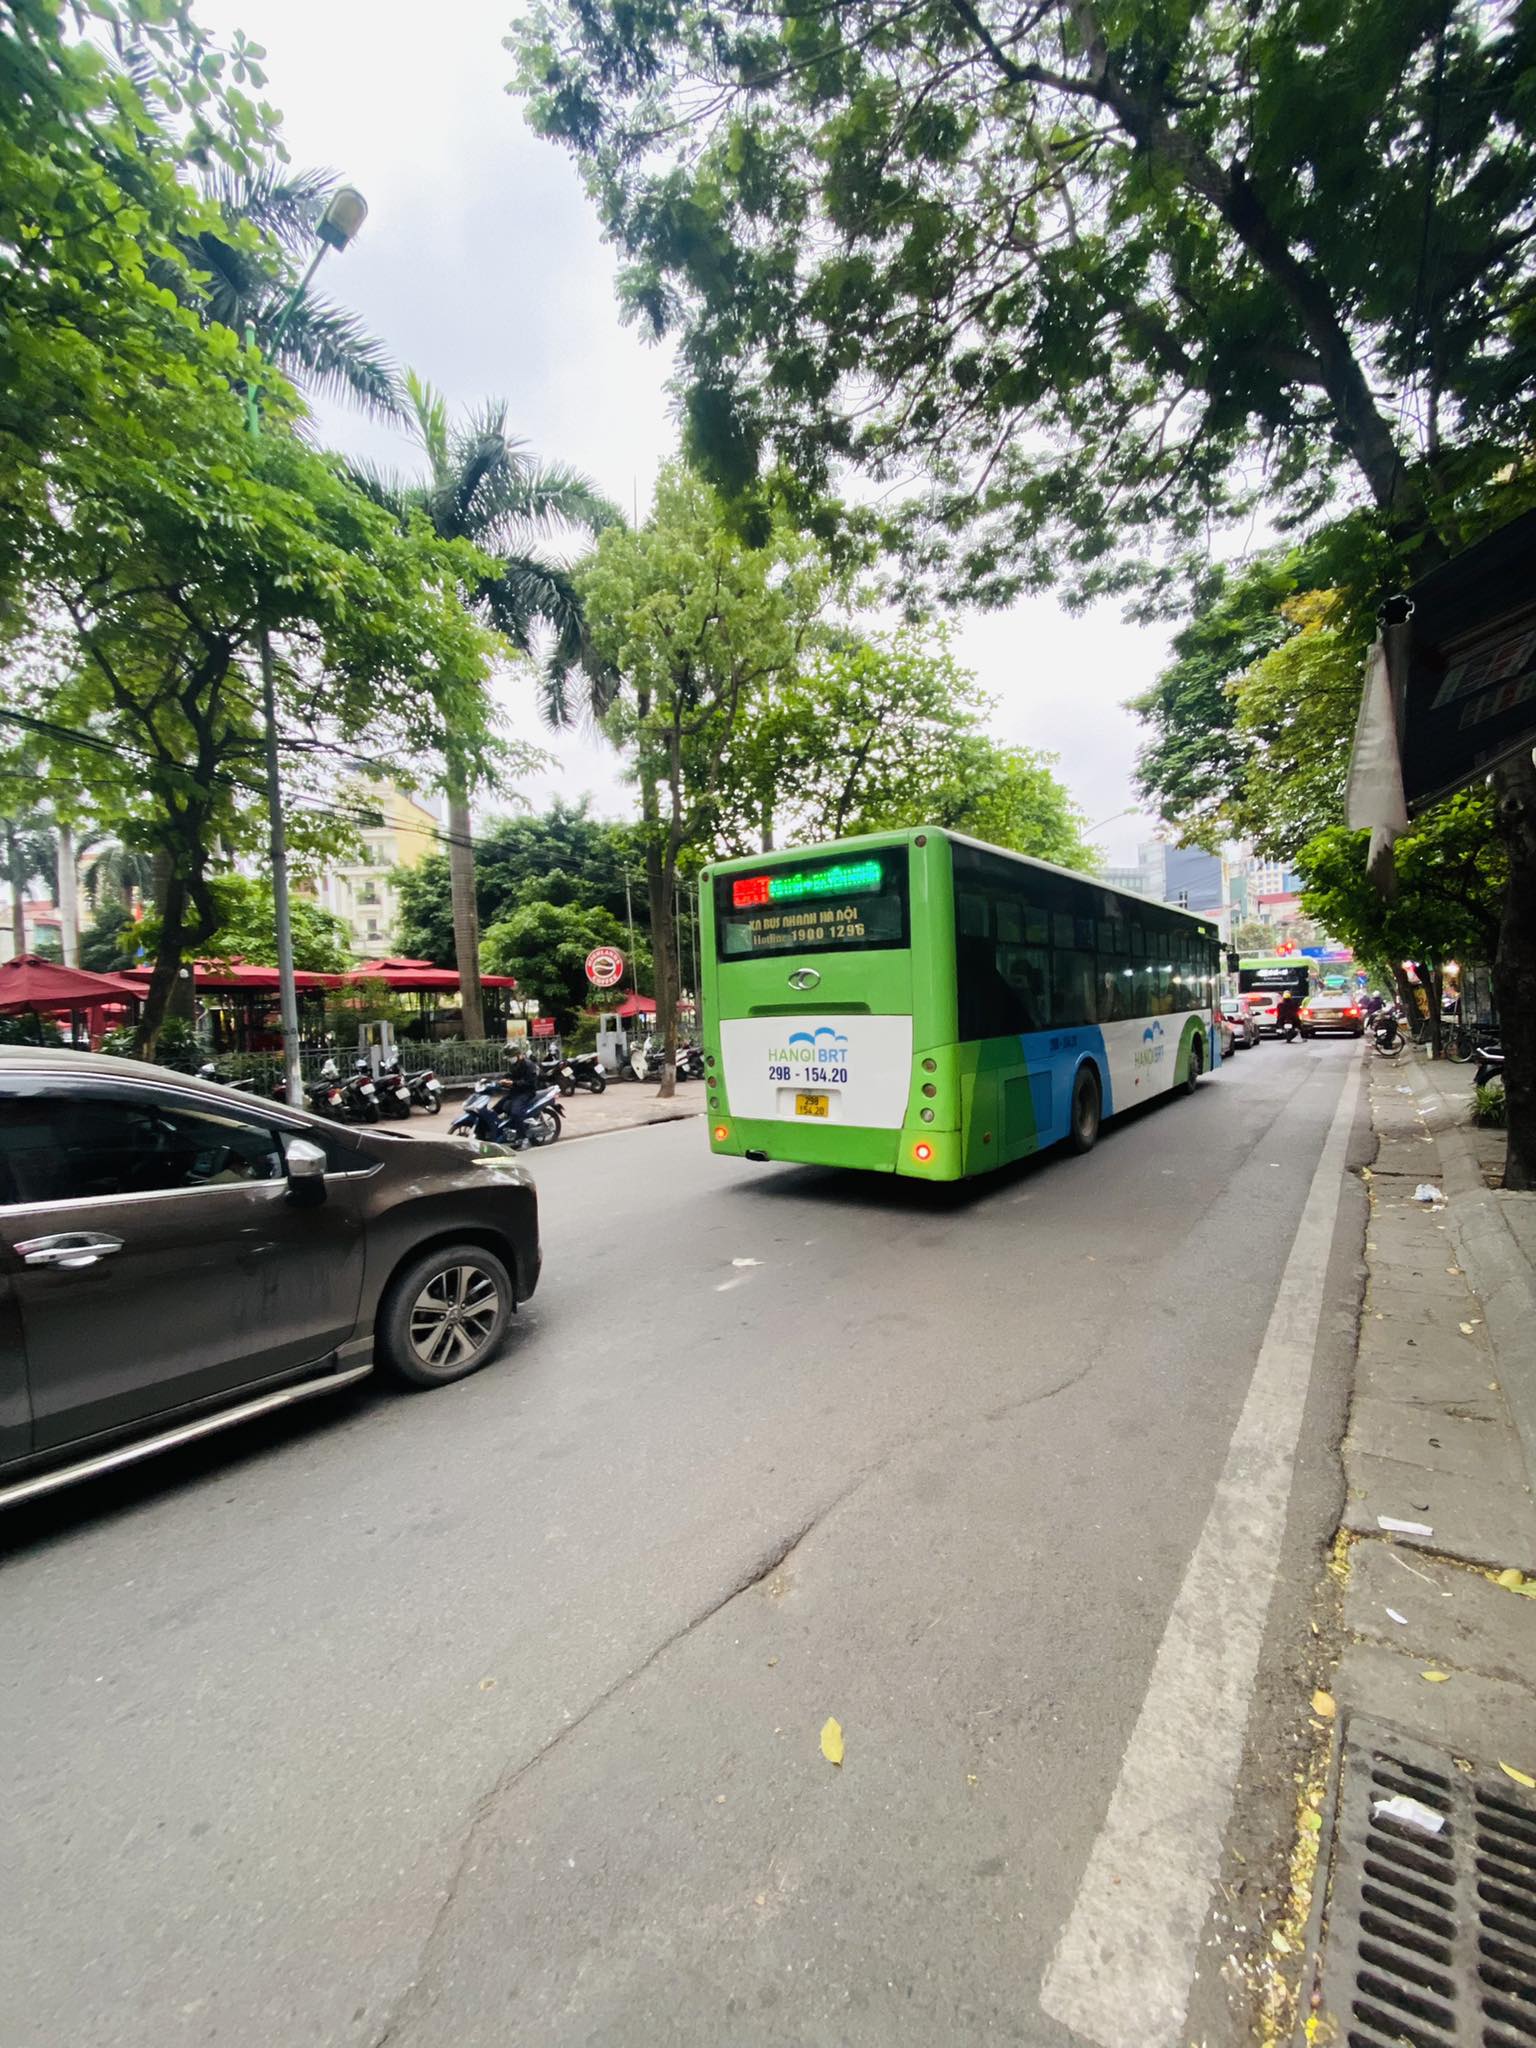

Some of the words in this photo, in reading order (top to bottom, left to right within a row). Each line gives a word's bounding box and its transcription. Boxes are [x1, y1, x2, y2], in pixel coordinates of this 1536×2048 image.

[763, 917, 780, 930] BUS
[792, 926, 824, 941] 1900
[830, 923, 865, 938] 1296
[768, 1048, 815, 1062] HANOI
[818, 1048, 848, 1062] BRT
[768, 1066, 791, 1081] 29B
[804, 1067, 848, 1083] 154.20
